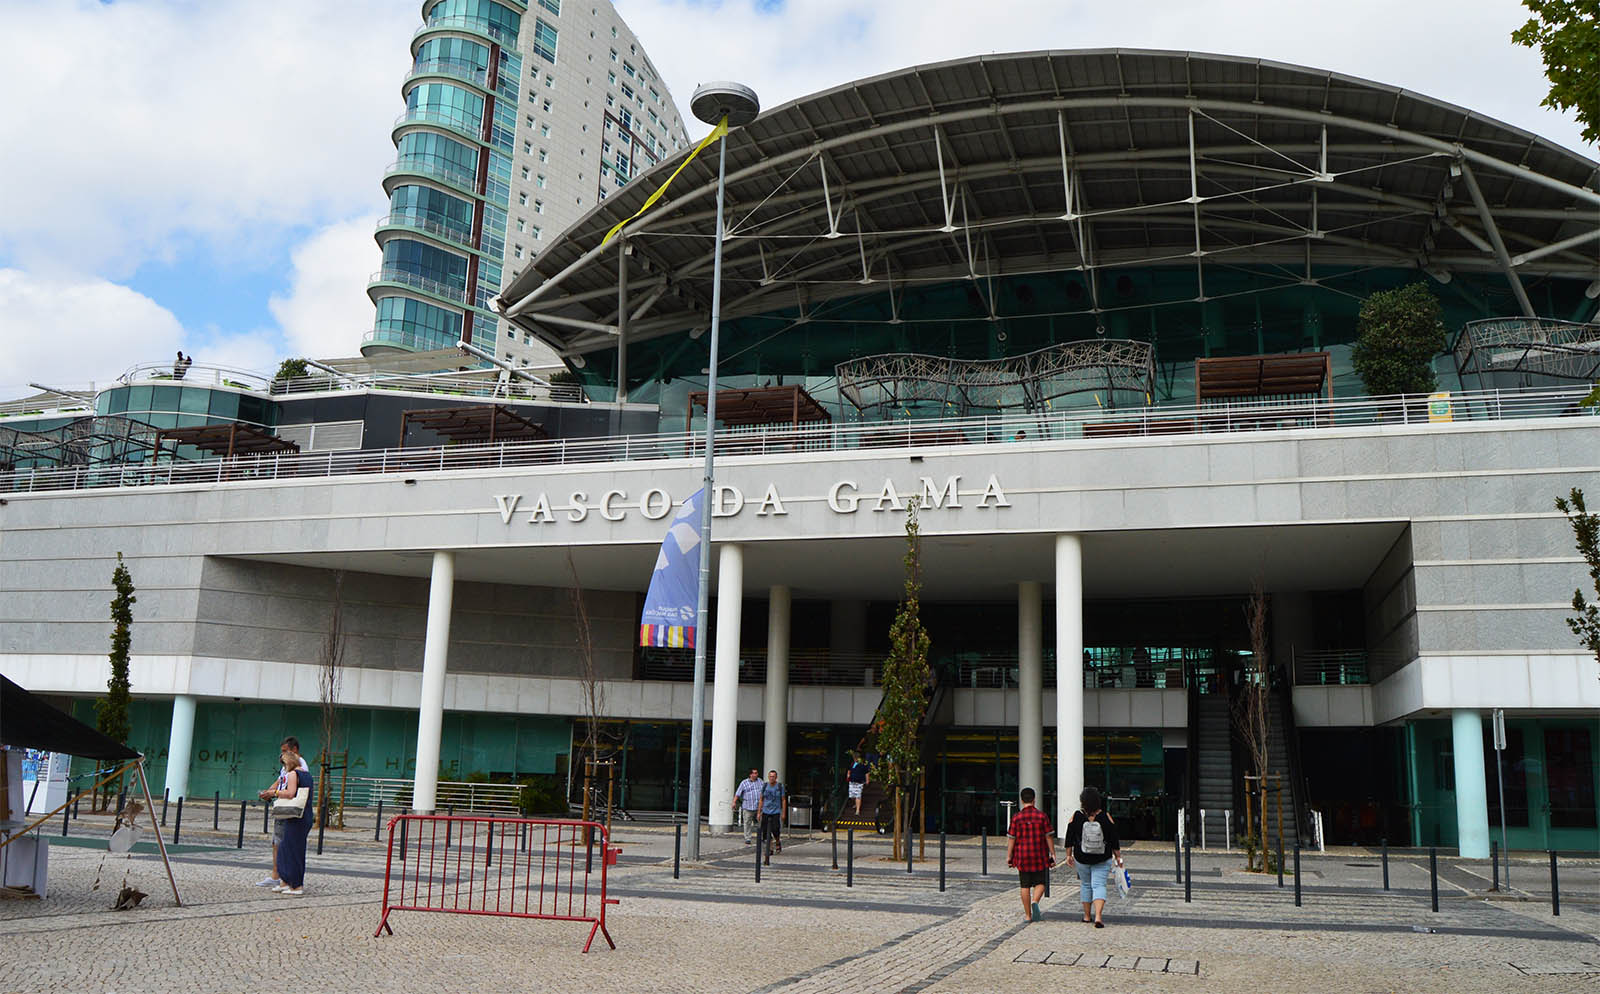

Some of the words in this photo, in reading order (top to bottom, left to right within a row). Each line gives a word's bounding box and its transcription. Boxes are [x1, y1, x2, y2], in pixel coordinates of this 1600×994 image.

[493, 488, 673, 524] VASCO
[712, 482, 788, 517] DA
[827, 473, 1012, 514] GAMA
